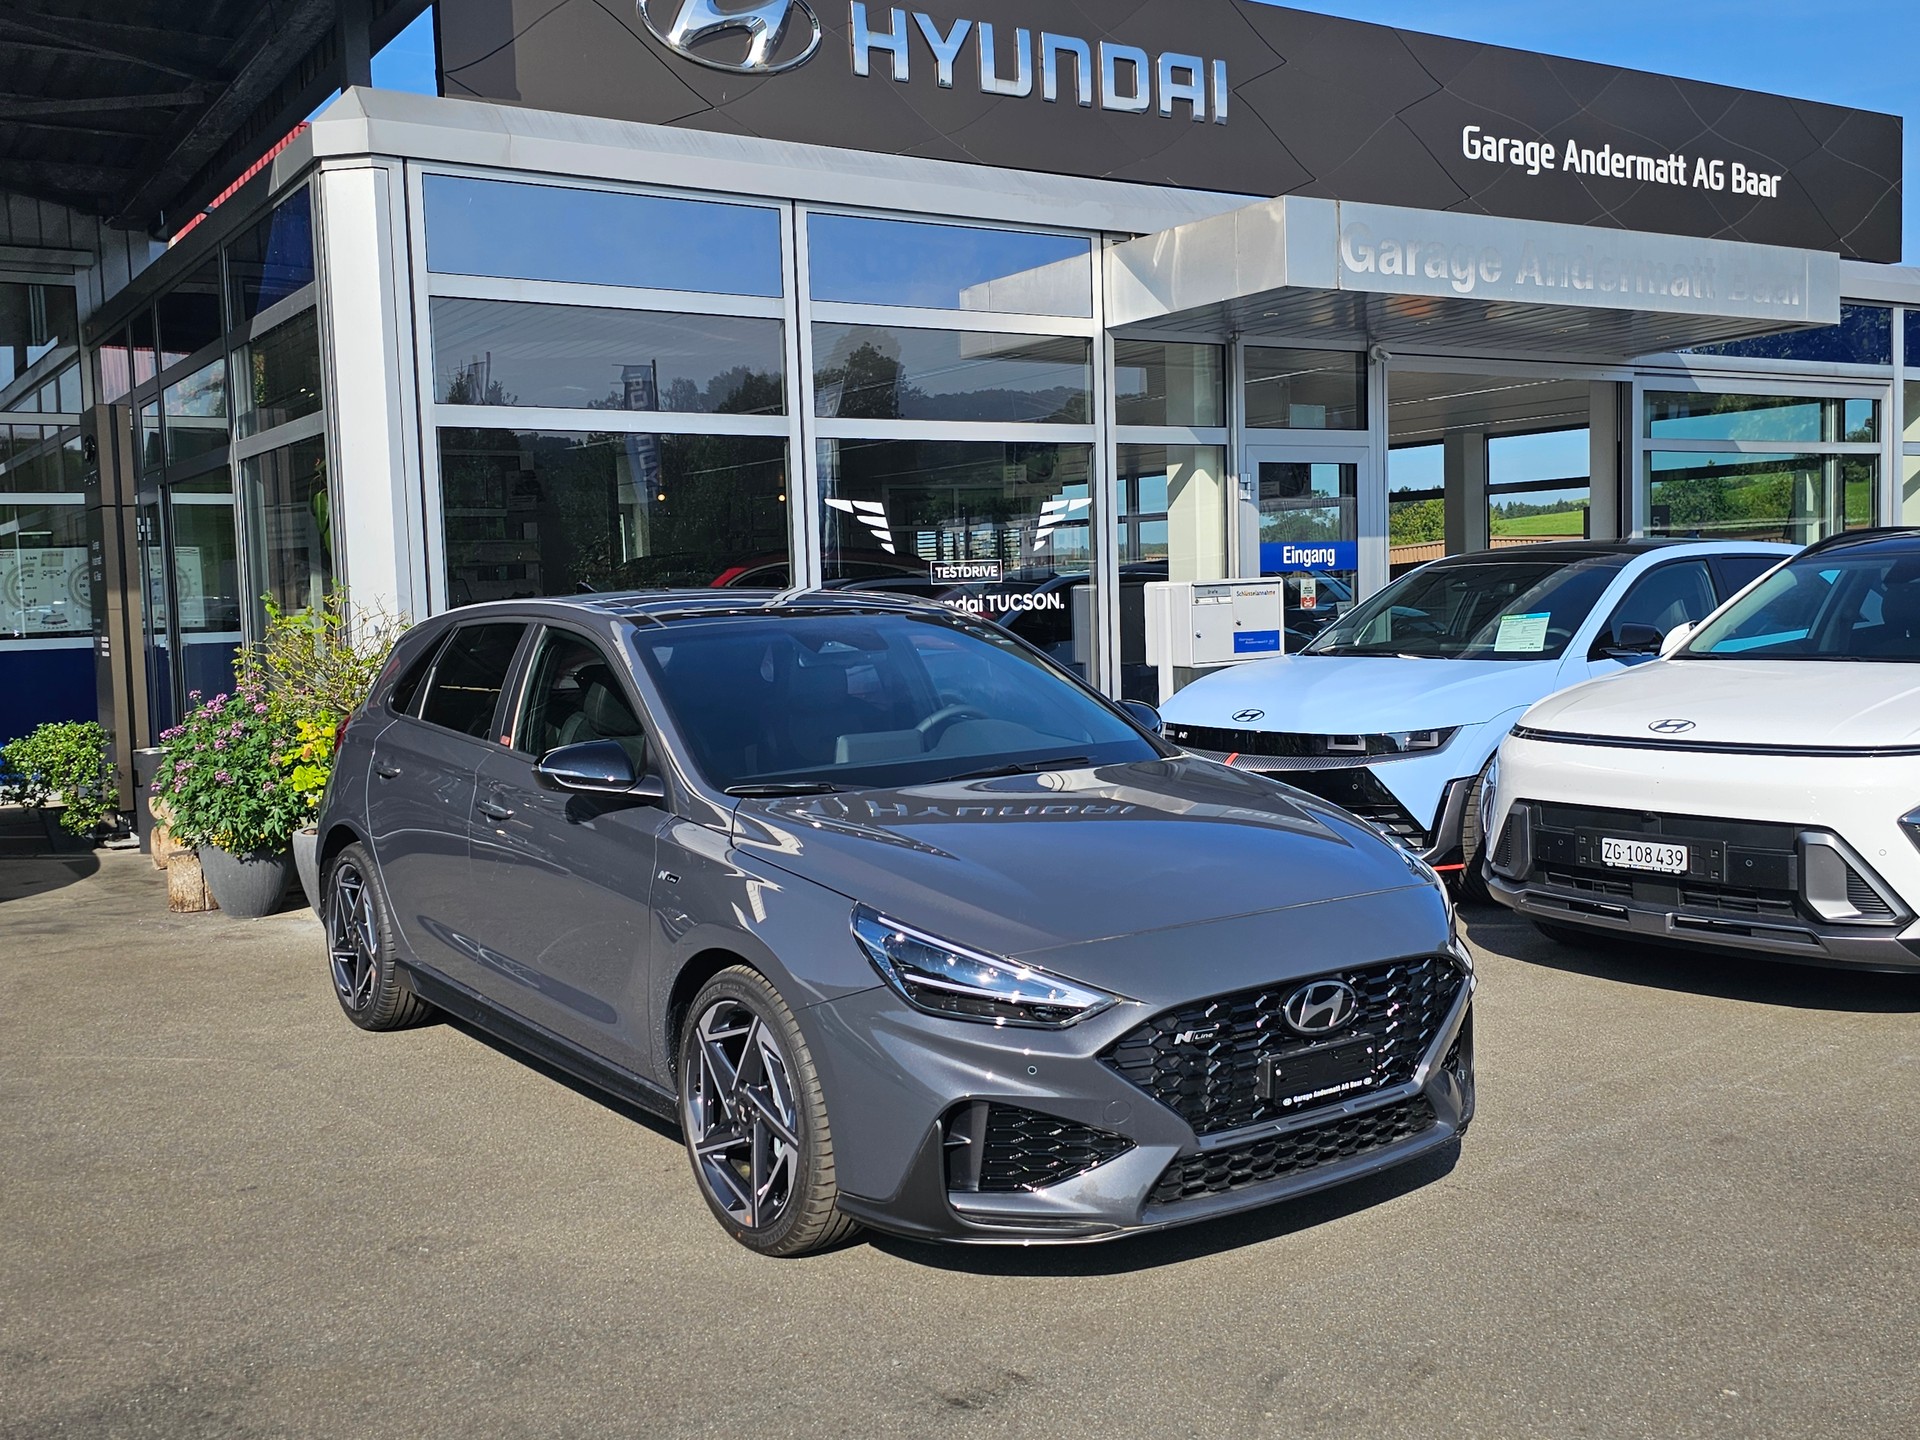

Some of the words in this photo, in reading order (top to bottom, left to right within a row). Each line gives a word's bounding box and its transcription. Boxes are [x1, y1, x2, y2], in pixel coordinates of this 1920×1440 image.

[851, 0, 1228, 125] HYUNDAI
[1462, 125, 1555, 176] Garage
[1562, 139, 1688, 187] Andermatt
[1692, 158, 1725, 192] AG
[1731, 164, 1782, 198] Baar
[1341, 221, 1502, 294] Garage
[1514, 239, 1717, 300] Andermatt
[935, 565, 998, 579] TESTDRIVE
[1283, 545, 1336, 567] Eingang
[986, 592, 1065, 612] TUCSON.
